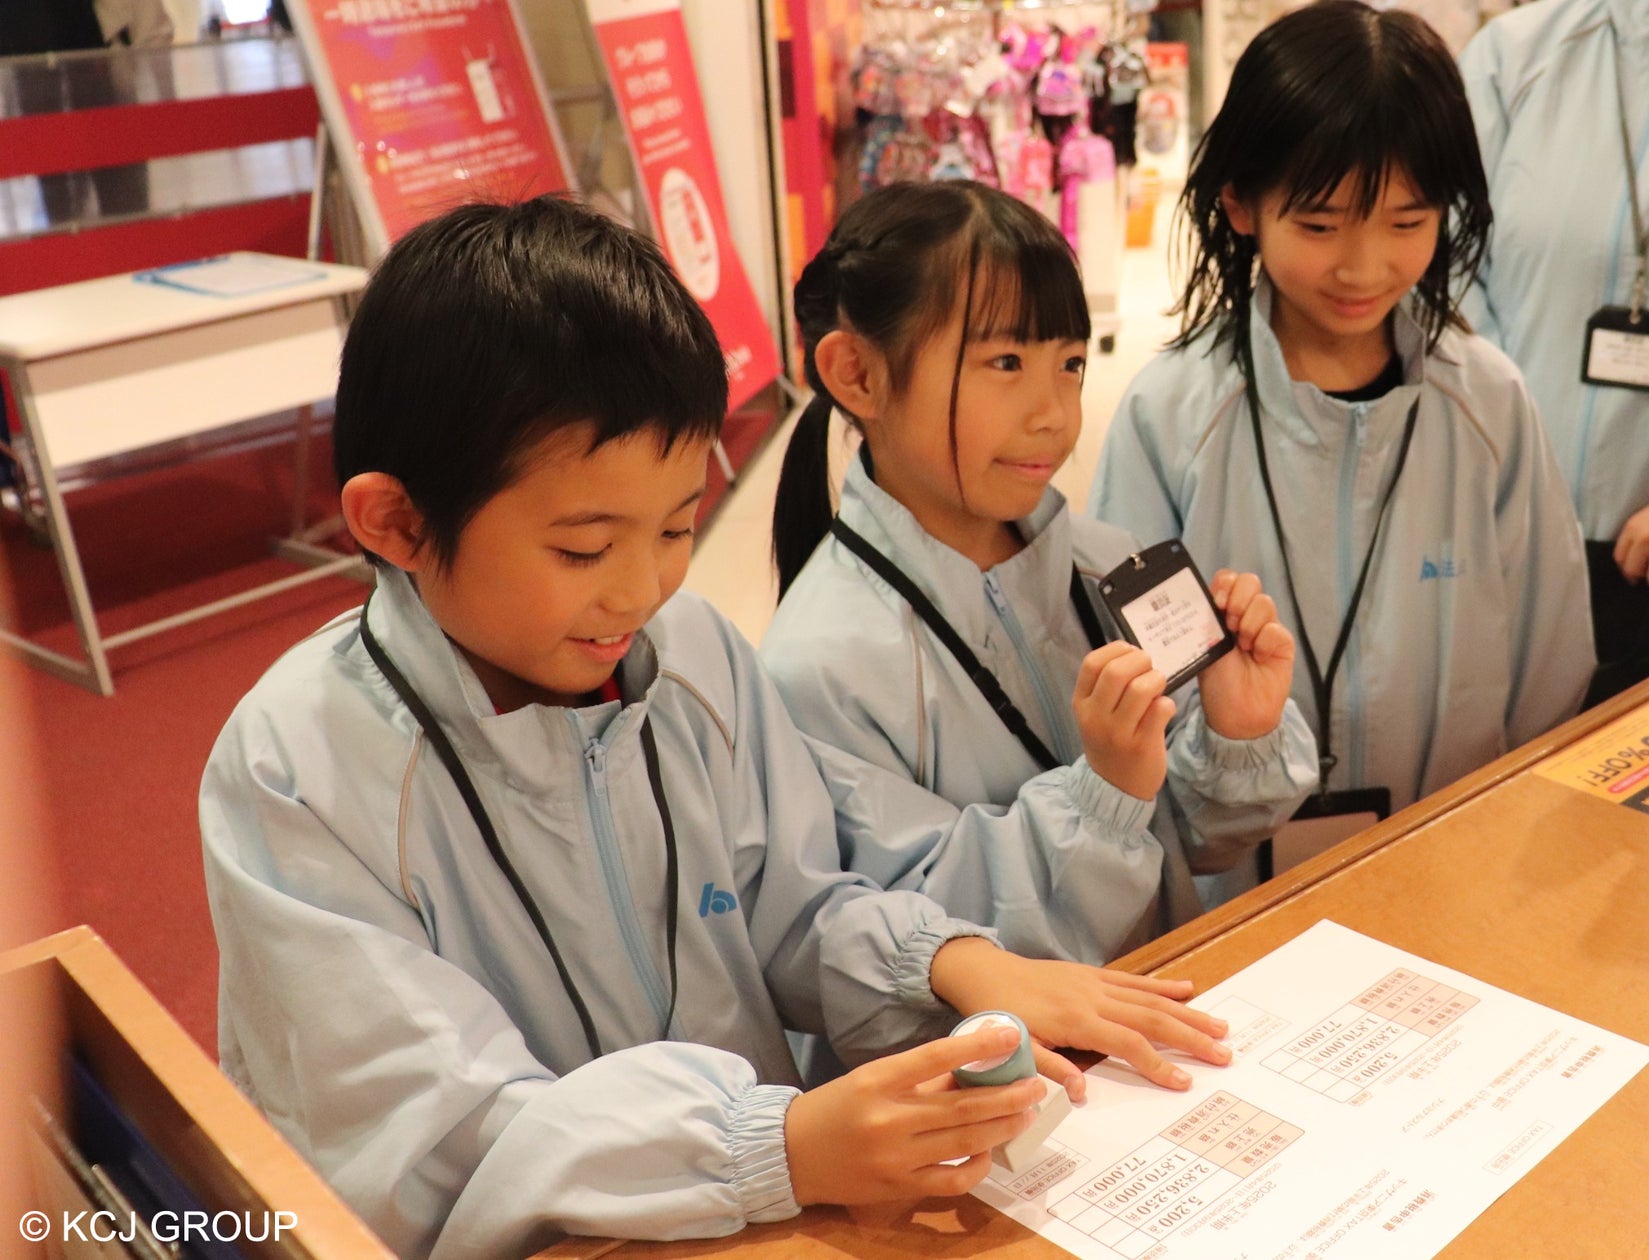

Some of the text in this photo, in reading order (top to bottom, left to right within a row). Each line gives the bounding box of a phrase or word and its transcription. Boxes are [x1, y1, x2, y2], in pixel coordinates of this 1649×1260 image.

[1166, 1095, 1228, 1137] 納付消費税額
[1196, 1112, 1240, 1142] 仕入れ額
[1222, 1125, 1257, 1150] 売上額
[1239, 1133, 1283, 1164] 販売数量
[1208, 1180, 1278, 1231] 2025年上半期
[1379, 1189, 1435, 1232] 消費税申告書
[1313, 1228, 1347, 1253] OFFICE
